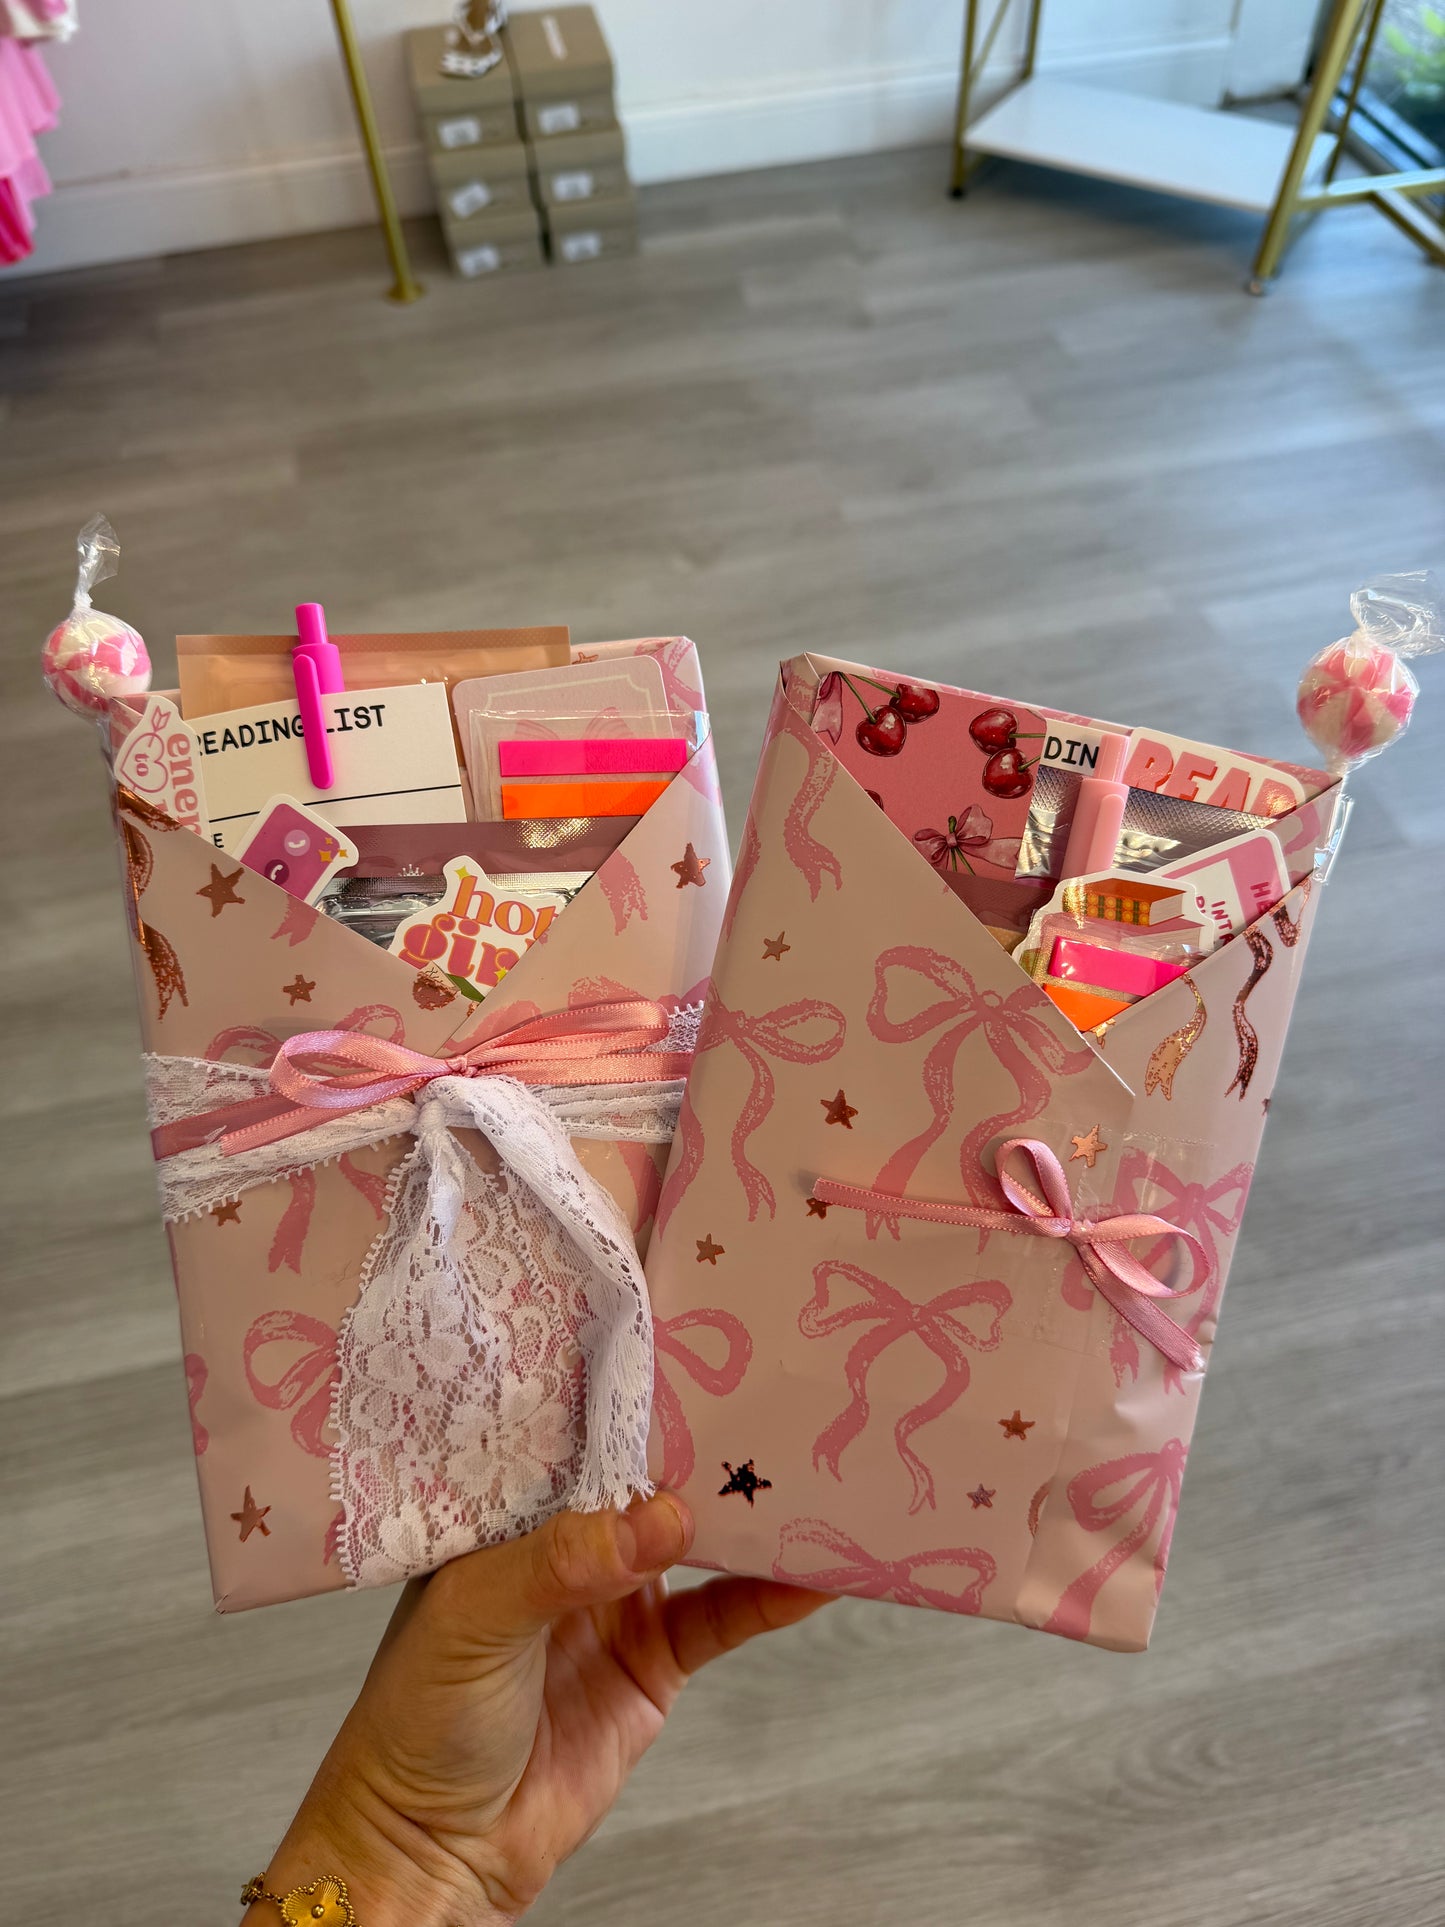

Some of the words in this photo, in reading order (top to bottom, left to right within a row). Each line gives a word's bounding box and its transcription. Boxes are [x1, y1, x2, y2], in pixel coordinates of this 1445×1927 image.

[197, 715, 305, 756] EADING
[326, 704, 386, 734] IST
[134, 753, 149, 777] to
